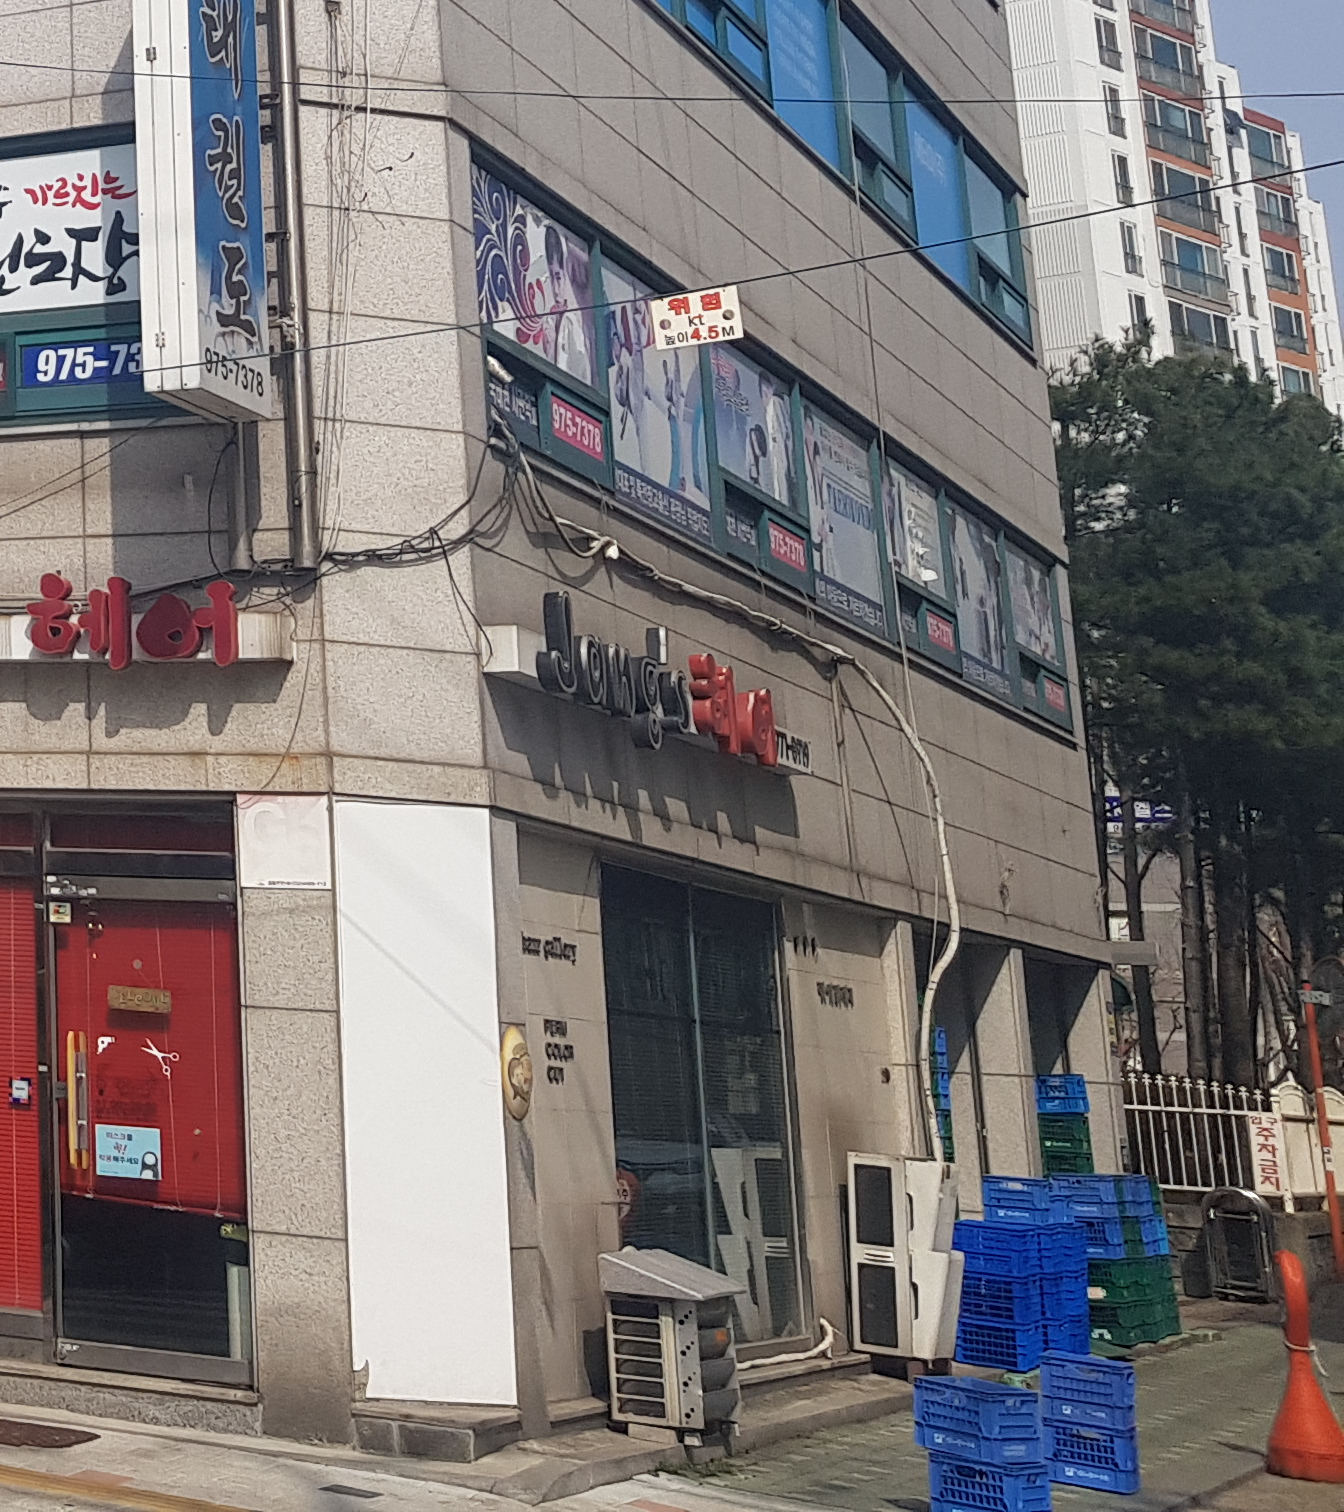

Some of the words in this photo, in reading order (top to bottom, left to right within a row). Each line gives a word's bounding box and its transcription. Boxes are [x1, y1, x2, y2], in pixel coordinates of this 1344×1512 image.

[688, 314, 705, 328] kt
[204, 345, 265, 398] 975-7378
[552, 401, 602, 453] 975-7378
[26, 572, 240, 670] 헤어
[1254, 1125, 1281, 1192] 주차금지
